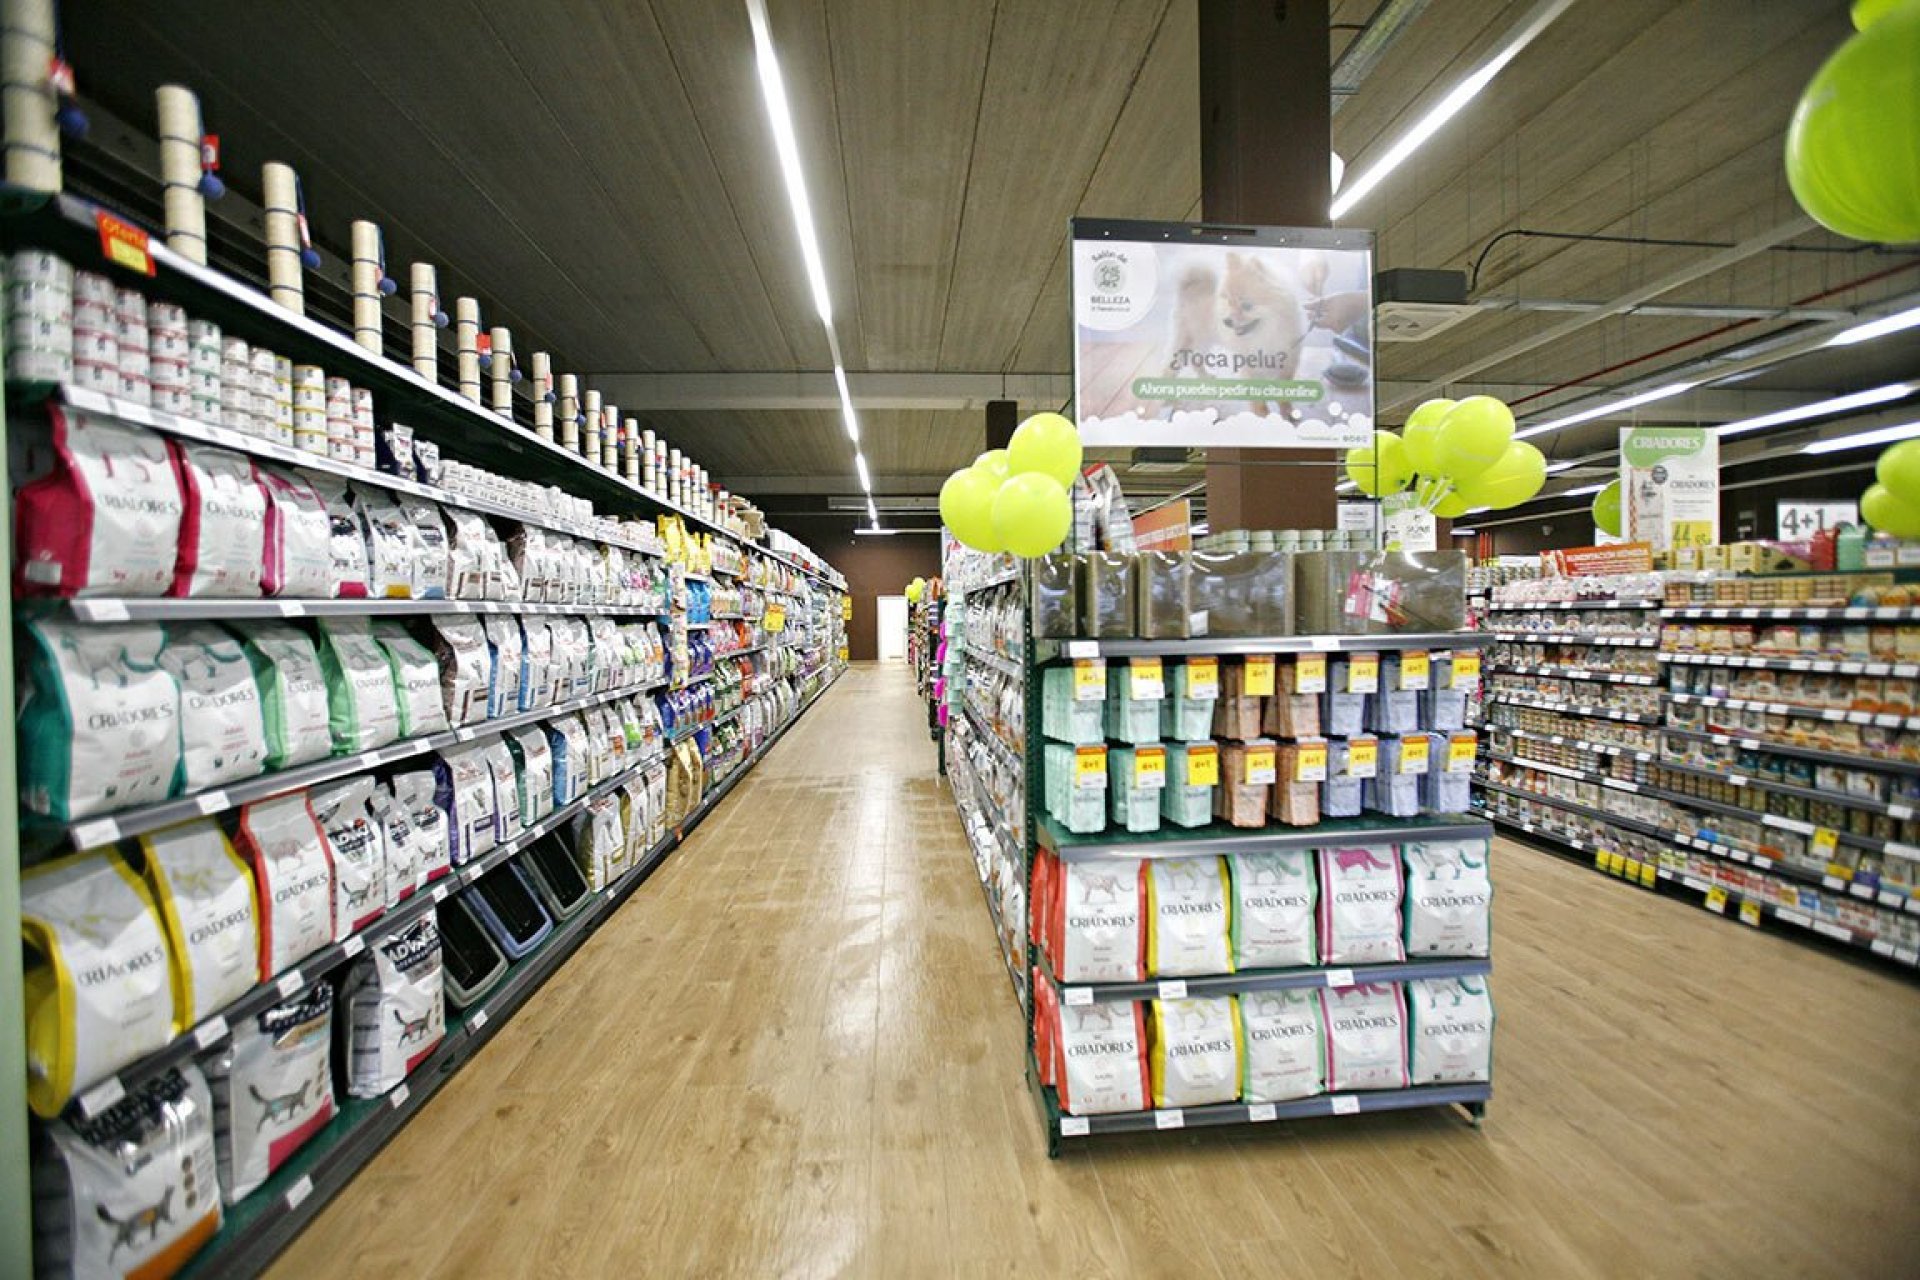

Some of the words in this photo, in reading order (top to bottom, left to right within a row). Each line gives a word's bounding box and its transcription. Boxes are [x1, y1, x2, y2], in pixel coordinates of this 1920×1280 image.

[1090, 296, 1131, 304] BELLEZA
[1169, 350, 1228, 371] ¿Toca
[1233, 350, 1288, 372] pelu?
[1139, 383, 1174, 396] Ahora
[1176, 383, 1216, 398] puedes
[1219, 384, 1248, 398] pedir
[1250, 385, 1261, 396] tu
[1263, 384, 1283, 396] cita
[1284, 385, 1318, 397] online
[1245, 895, 1308, 909] CRIADORES
[1336, 889, 1397, 903] CRIADORES
[1421, 894, 1485, 908] CRIADORES
[1160, 902, 1223, 916] CRIADORES
[1069, 913, 1136, 929] CRIADORES
[1334, 1015, 1398, 1031] CRIADORES
[1424, 1022, 1486, 1036] CRIADORES
[1251, 1024, 1316, 1041] CRIADORES
[1068, 1040, 1134, 1057] CRIADORES
[1168, 1039, 1232, 1058] CRIADORES
